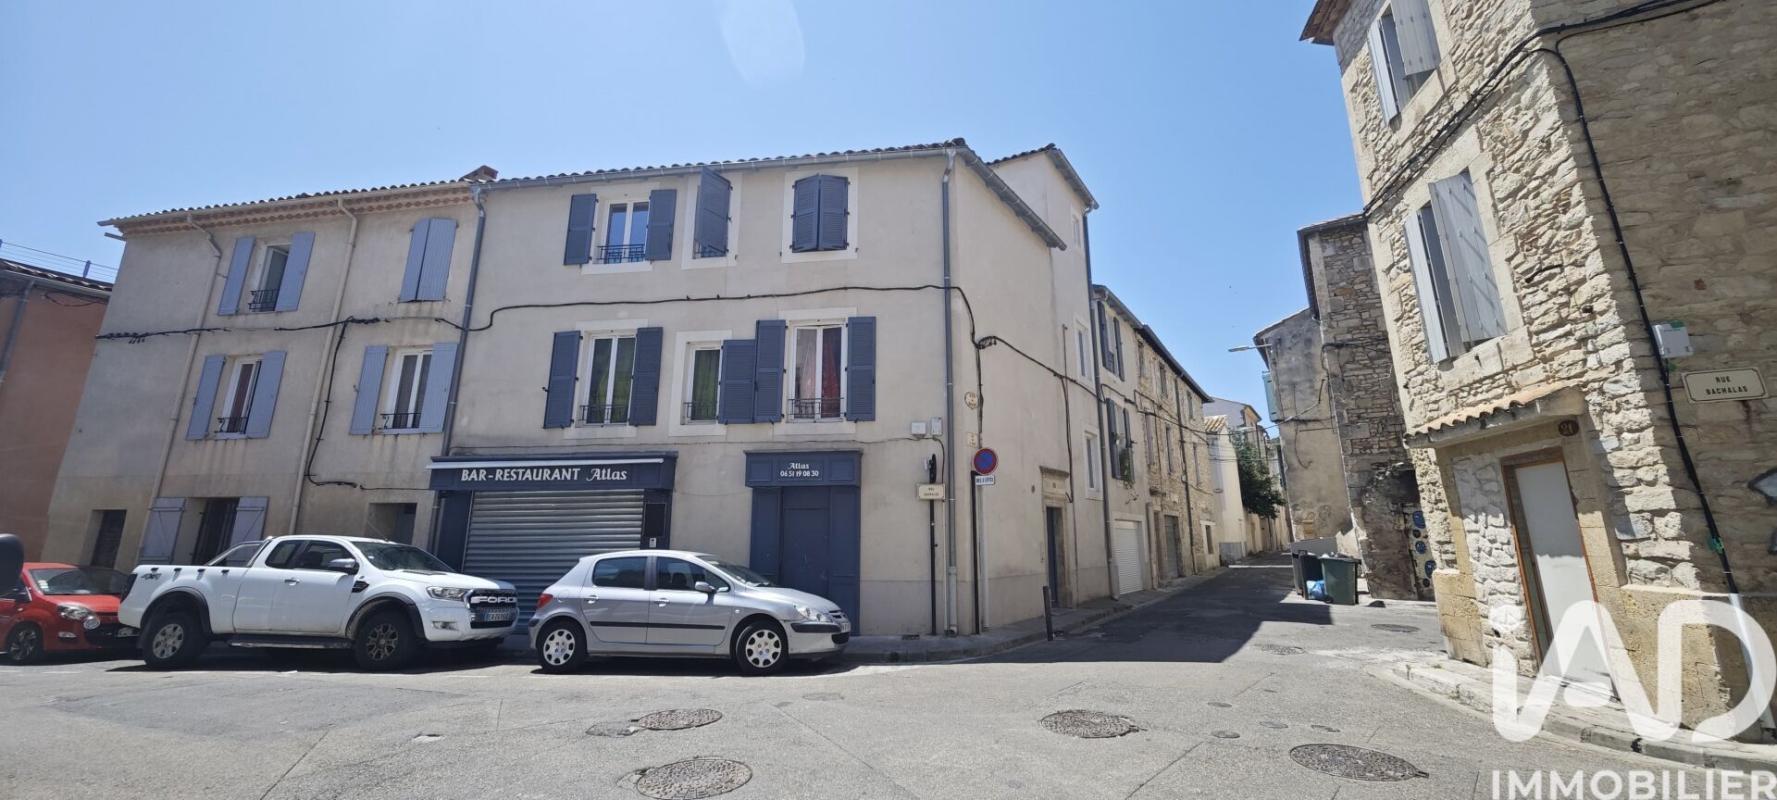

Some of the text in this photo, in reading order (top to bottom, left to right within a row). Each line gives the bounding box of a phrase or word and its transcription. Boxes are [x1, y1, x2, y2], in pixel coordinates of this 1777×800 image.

[787, 462, 810, 470] Atlas
[461, 468, 628, 482] BAR-RESTAURANT Atlas
[470, 596, 517, 604] FORD
